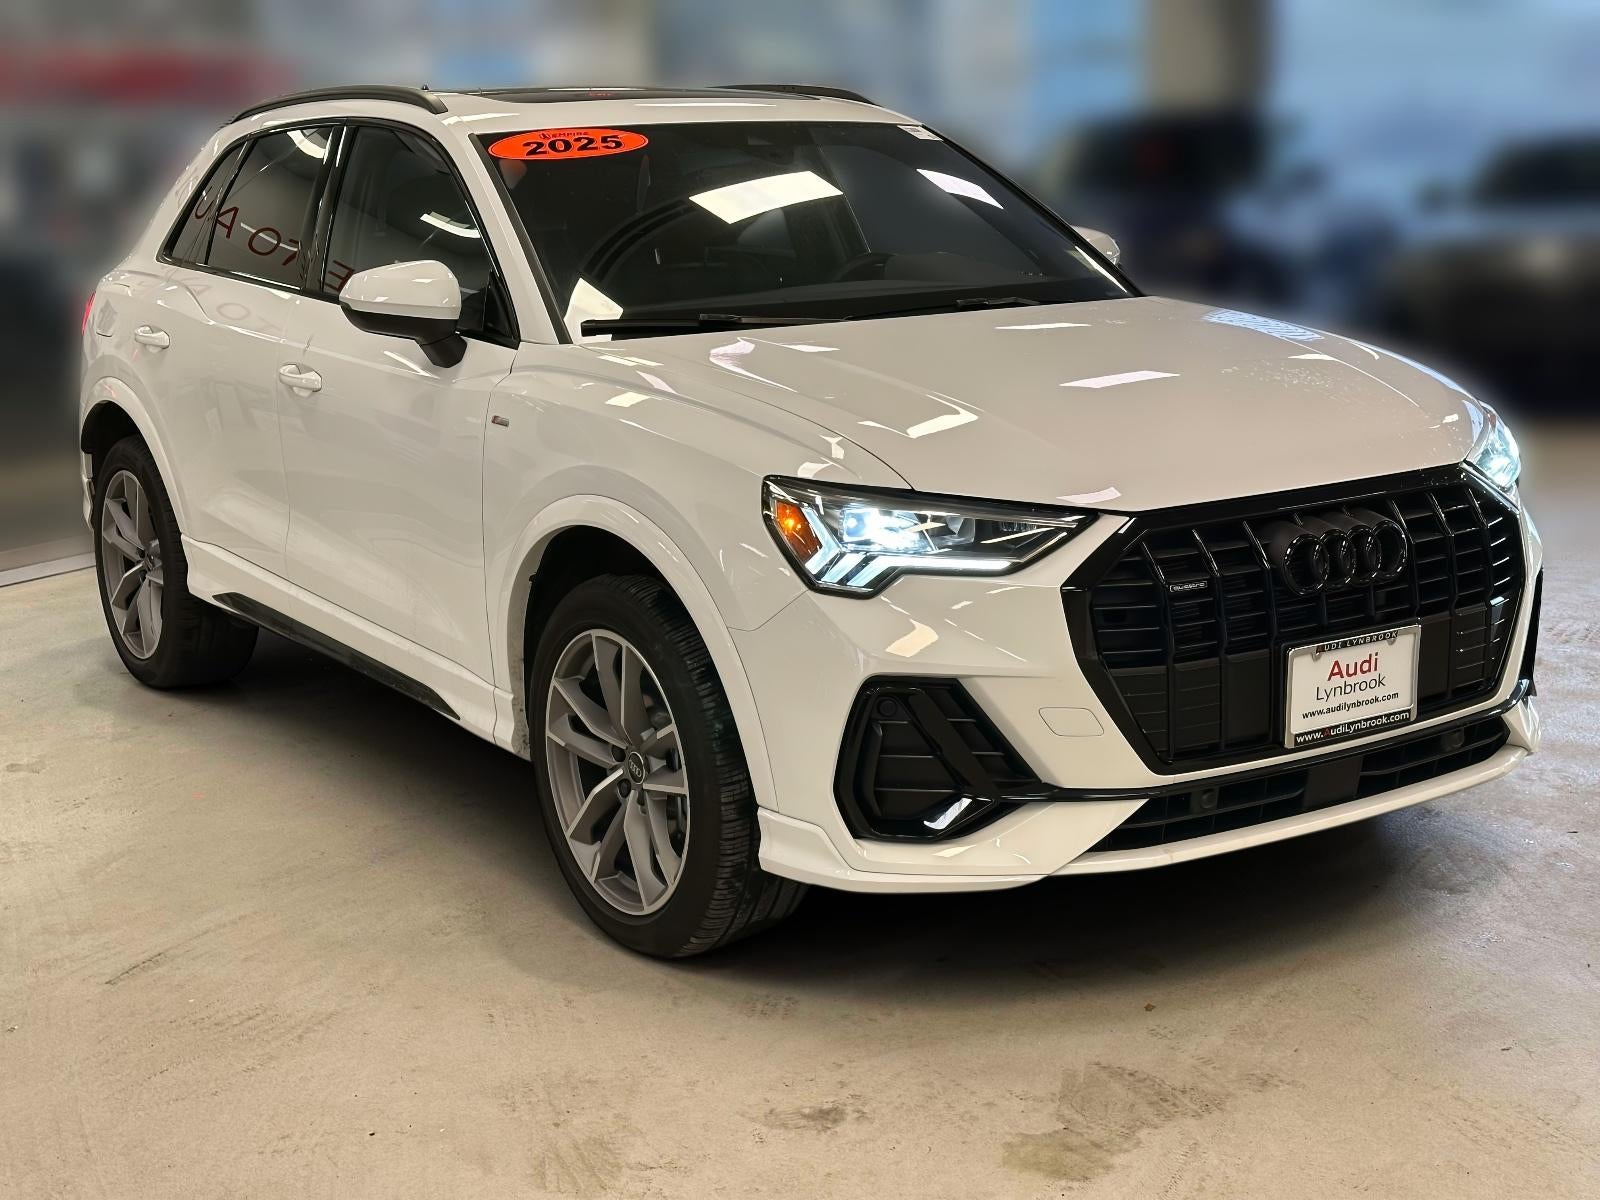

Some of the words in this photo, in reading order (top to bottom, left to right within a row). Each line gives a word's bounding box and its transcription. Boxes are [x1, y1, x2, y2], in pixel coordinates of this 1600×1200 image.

[523, 134, 624, 156] 2025
[1346, 630, 1398, 647] LYNBROOK
[1327, 651, 1379, 682] Audi
[1315, 673, 1386, 702] Lynbrook
[1302, 692, 1399, 719] www.audilynbrook.com
[1296, 711, 1409, 743] www.AudiLynbrook.com
